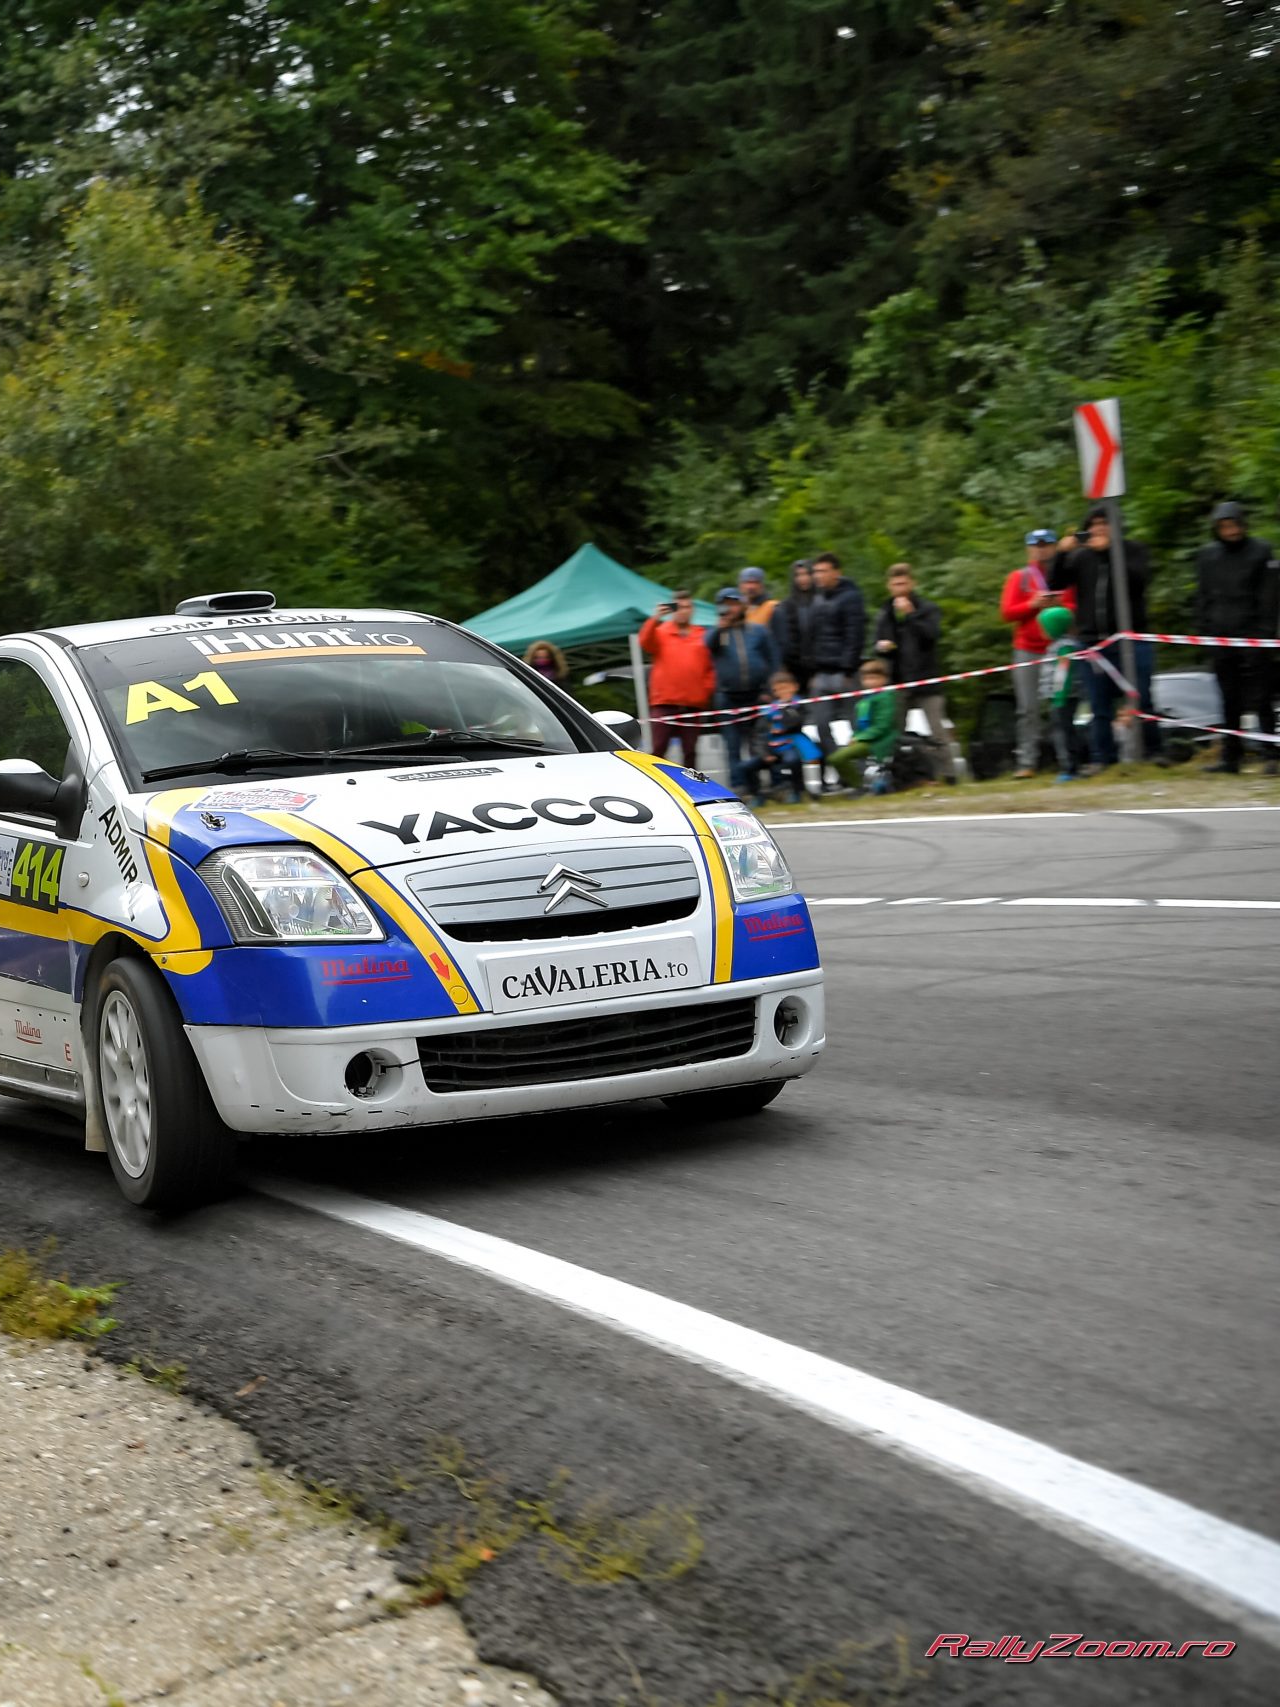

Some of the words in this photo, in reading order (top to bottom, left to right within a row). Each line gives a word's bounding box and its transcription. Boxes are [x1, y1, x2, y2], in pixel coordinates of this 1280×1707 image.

[150, 621, 213, 632] OMP
[126, 671, 239, 726] A1
[360, 796, 653, 845] YACCO
[12, 842, 63, 905] 414
[321, 956, 408, 977] Malina
[502, 957, 688, 999] CAVALERIA.ro
[15, 1019, 41, 1038] Malina
[64, 1043, 72, 1062] E
